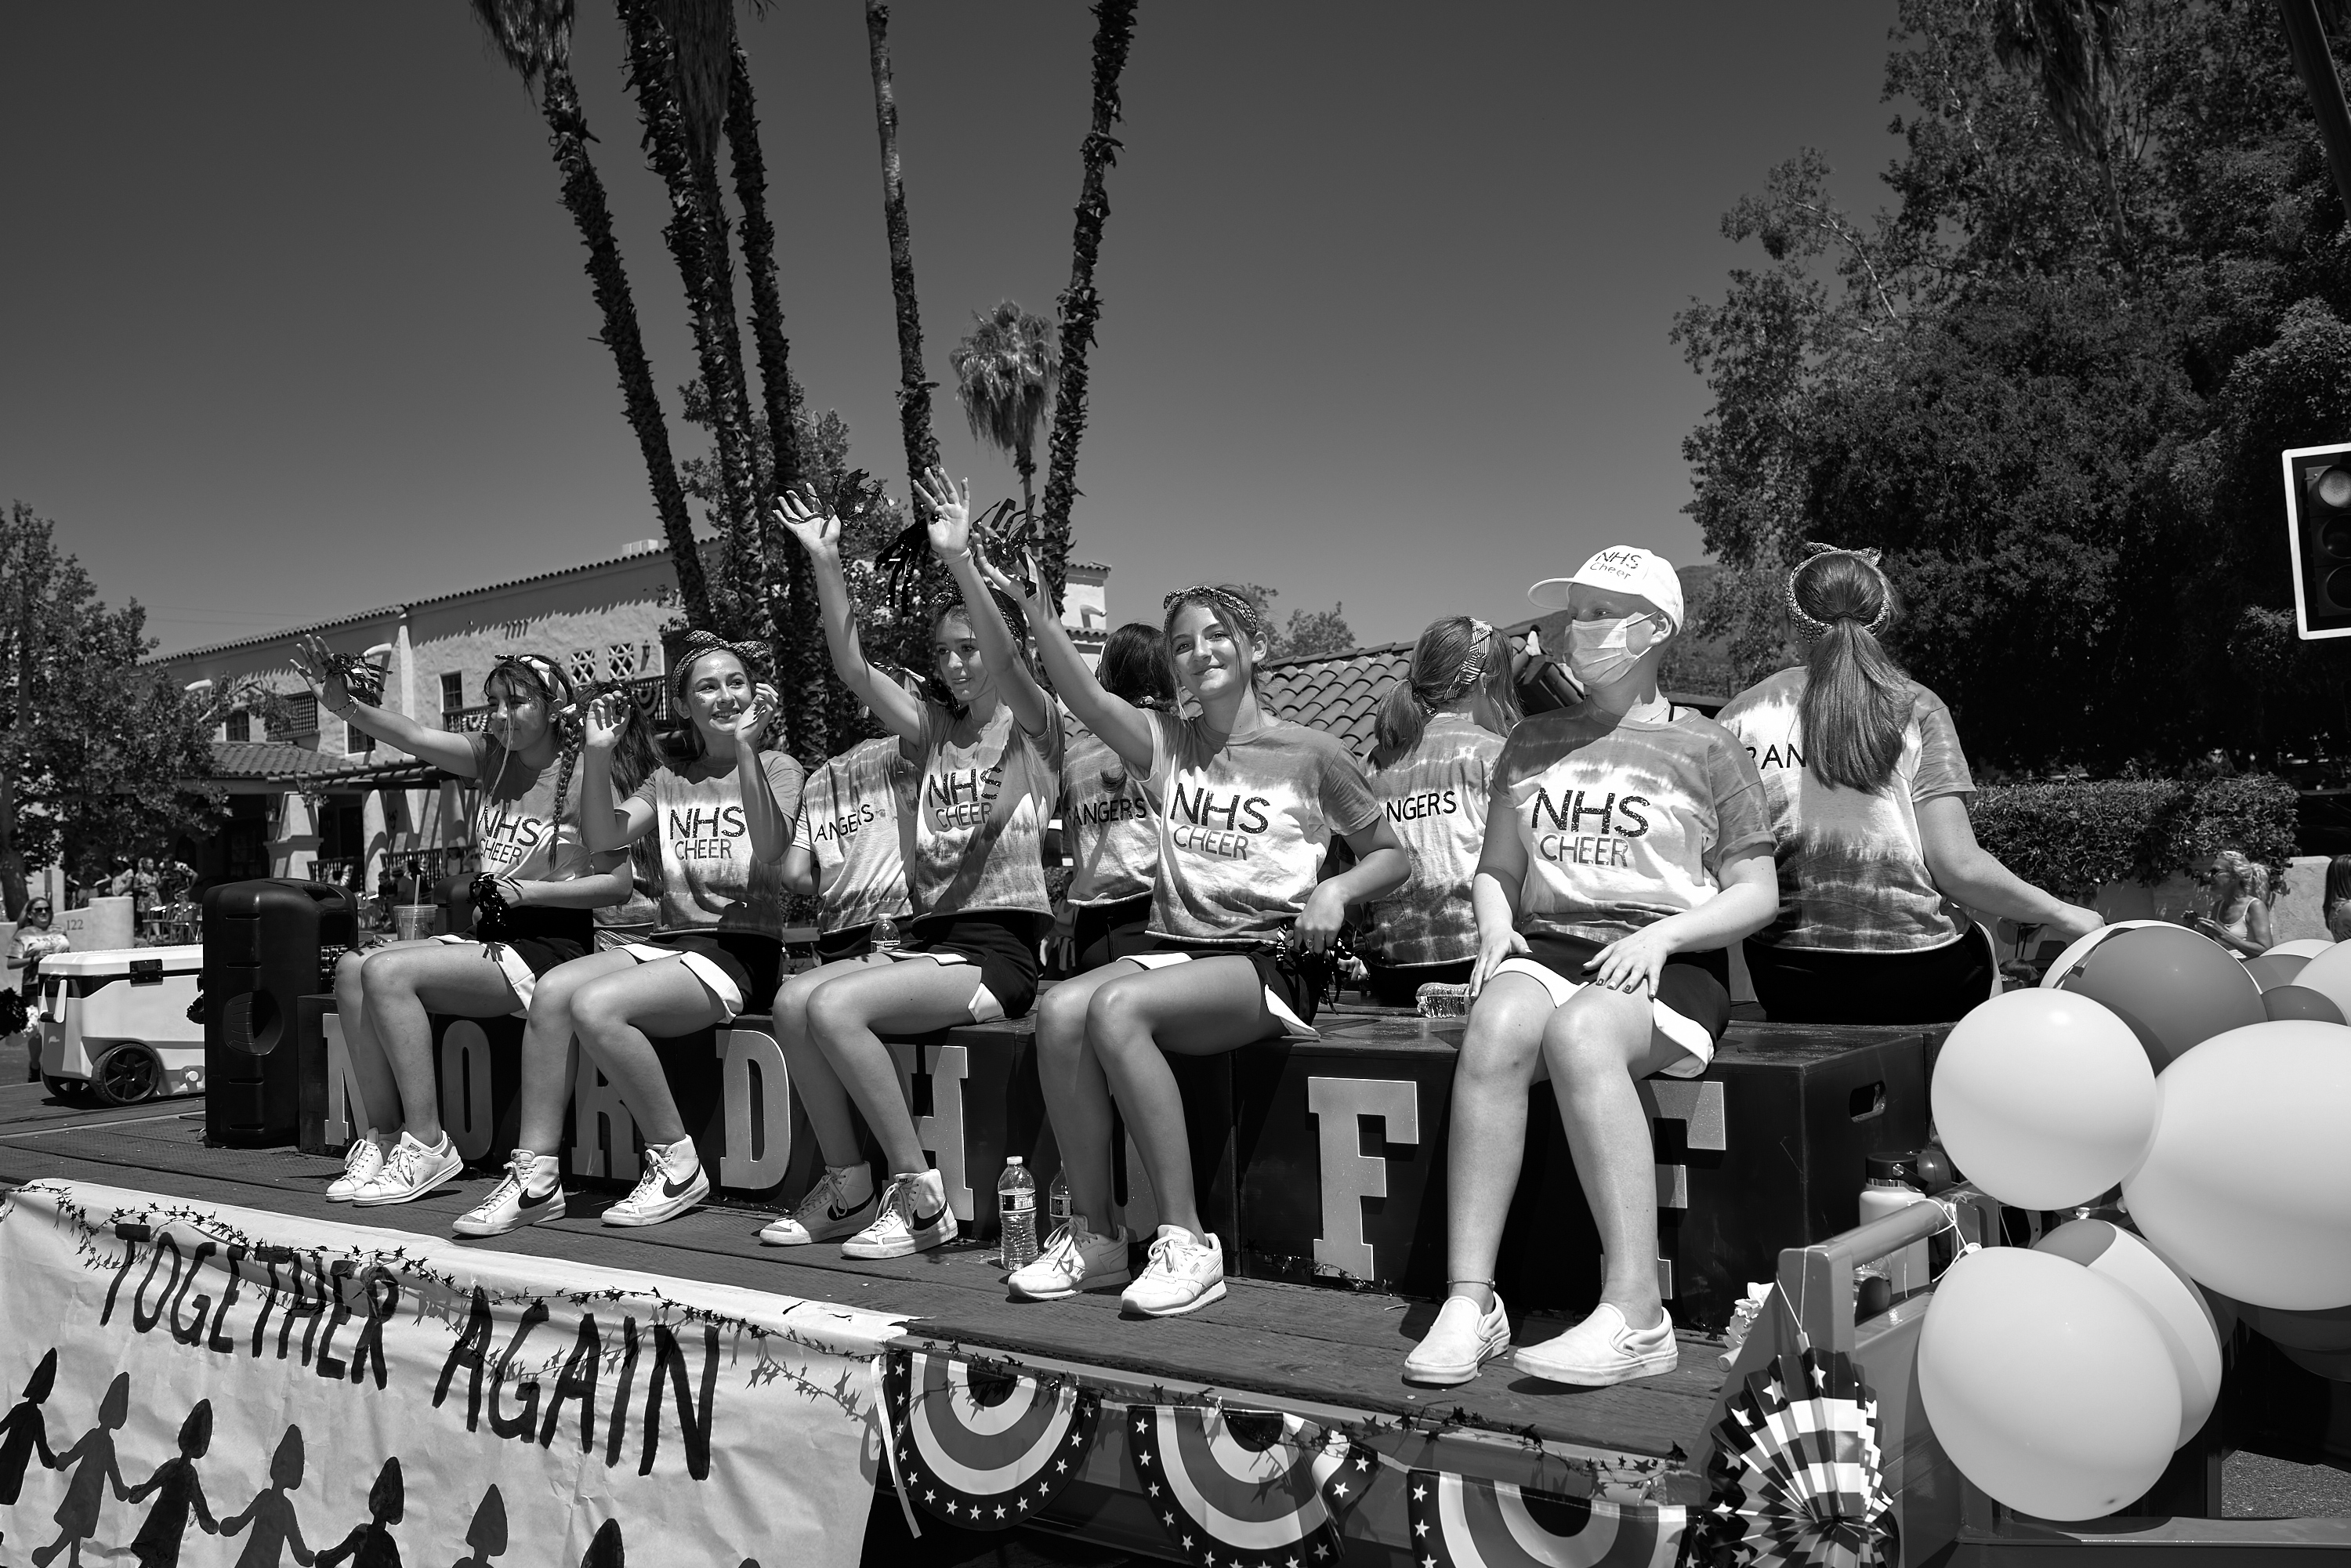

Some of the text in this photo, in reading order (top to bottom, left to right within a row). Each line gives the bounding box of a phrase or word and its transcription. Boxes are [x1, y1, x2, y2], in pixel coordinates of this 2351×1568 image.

[1590, 562, 1631, 580] Cheer
[1596, 551, 1643, 570] NHS
[928, 766, 1002, 808] NHS
[669, 806, 746, 840] NHS
[935, 802, 993, 829] CHEER
[1066, 797, 1147, 827] ANGERS
[1169, 783, 1270, 835] NHS
[1531, 787, 1651, 838] NHS
[476, 805, 542, 847] NHS
[1173, 824, 1249, 861] CHEER
[480, 838, 523, 866] CHEER
[675, 838, 733, 860] CHEER
[1538, 834, 1629, 867] CHEER
[66, 919, 84, 931] 122
[100, 1222, 721, 1482] TOGETHER AGAIN
